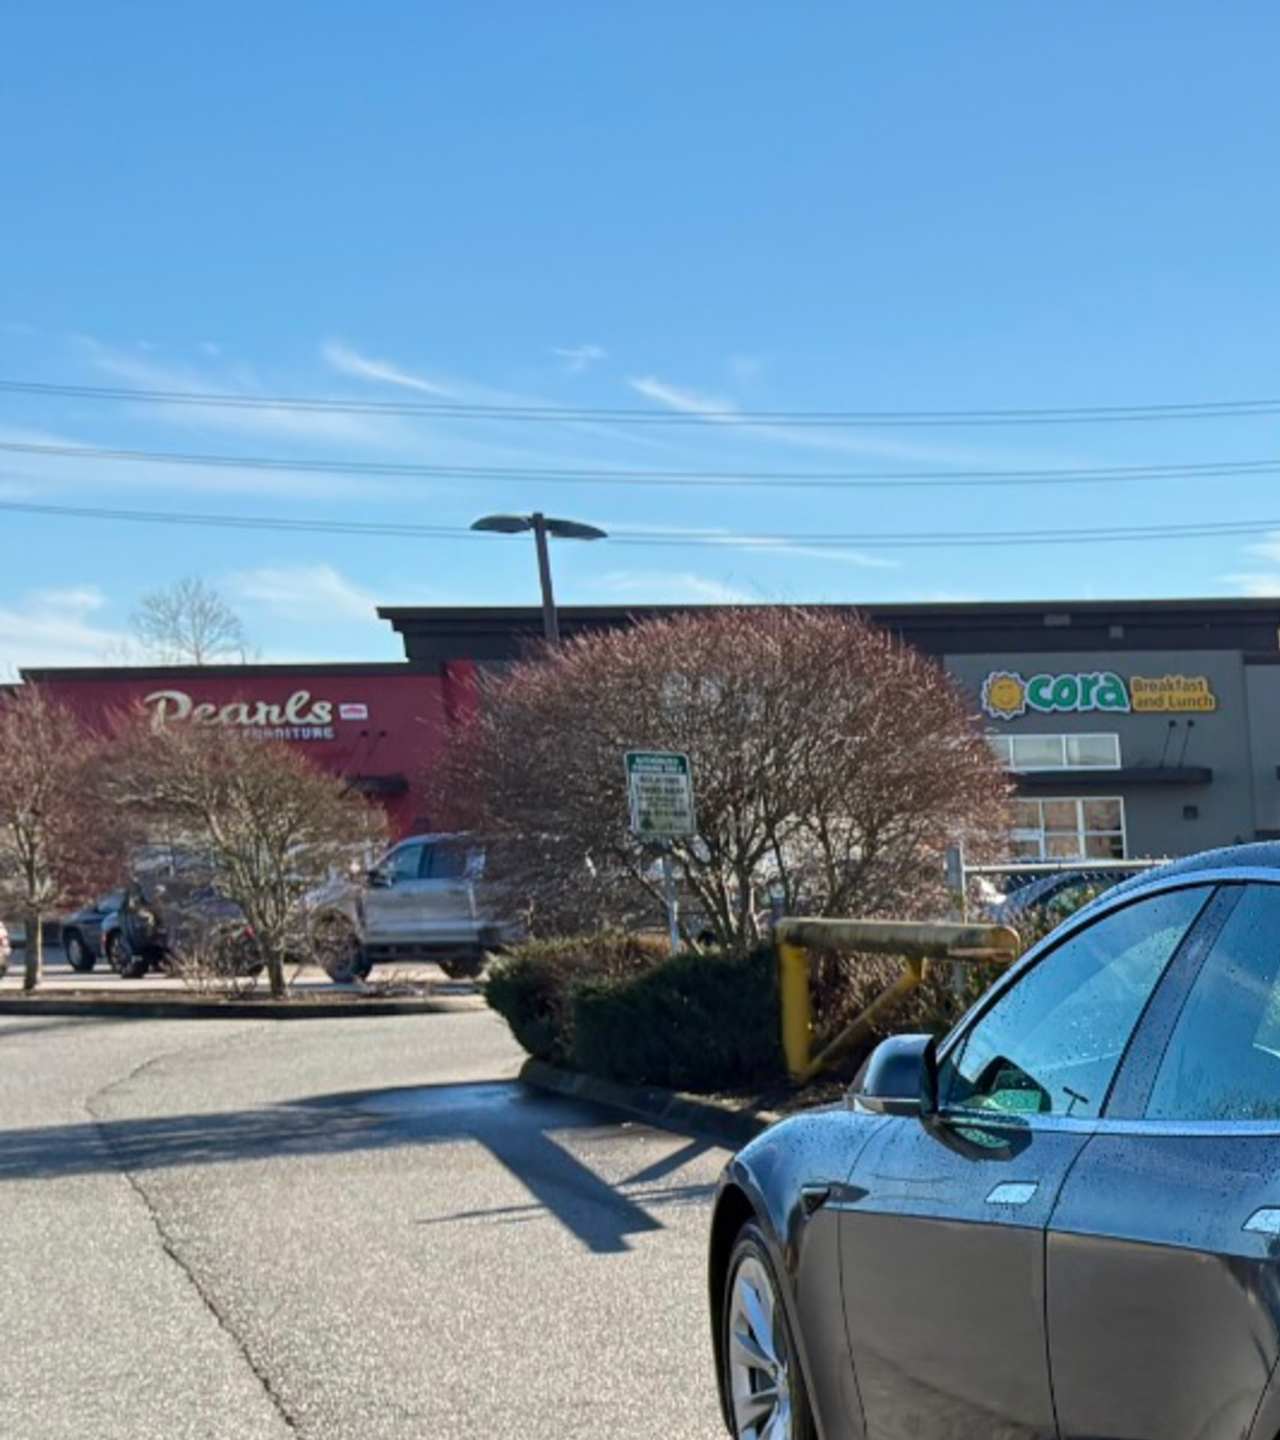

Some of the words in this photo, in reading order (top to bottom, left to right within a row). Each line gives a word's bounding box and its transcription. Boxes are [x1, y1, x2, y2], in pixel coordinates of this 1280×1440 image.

[1026, 673, 1130, 711] cora
[1133, 676, 1206, 693] Breakfast
[144, 690, 333, 735] Pearls
[1135, 693, 1163, 708] and
[1169, 693, 1214, 708] Lunch
